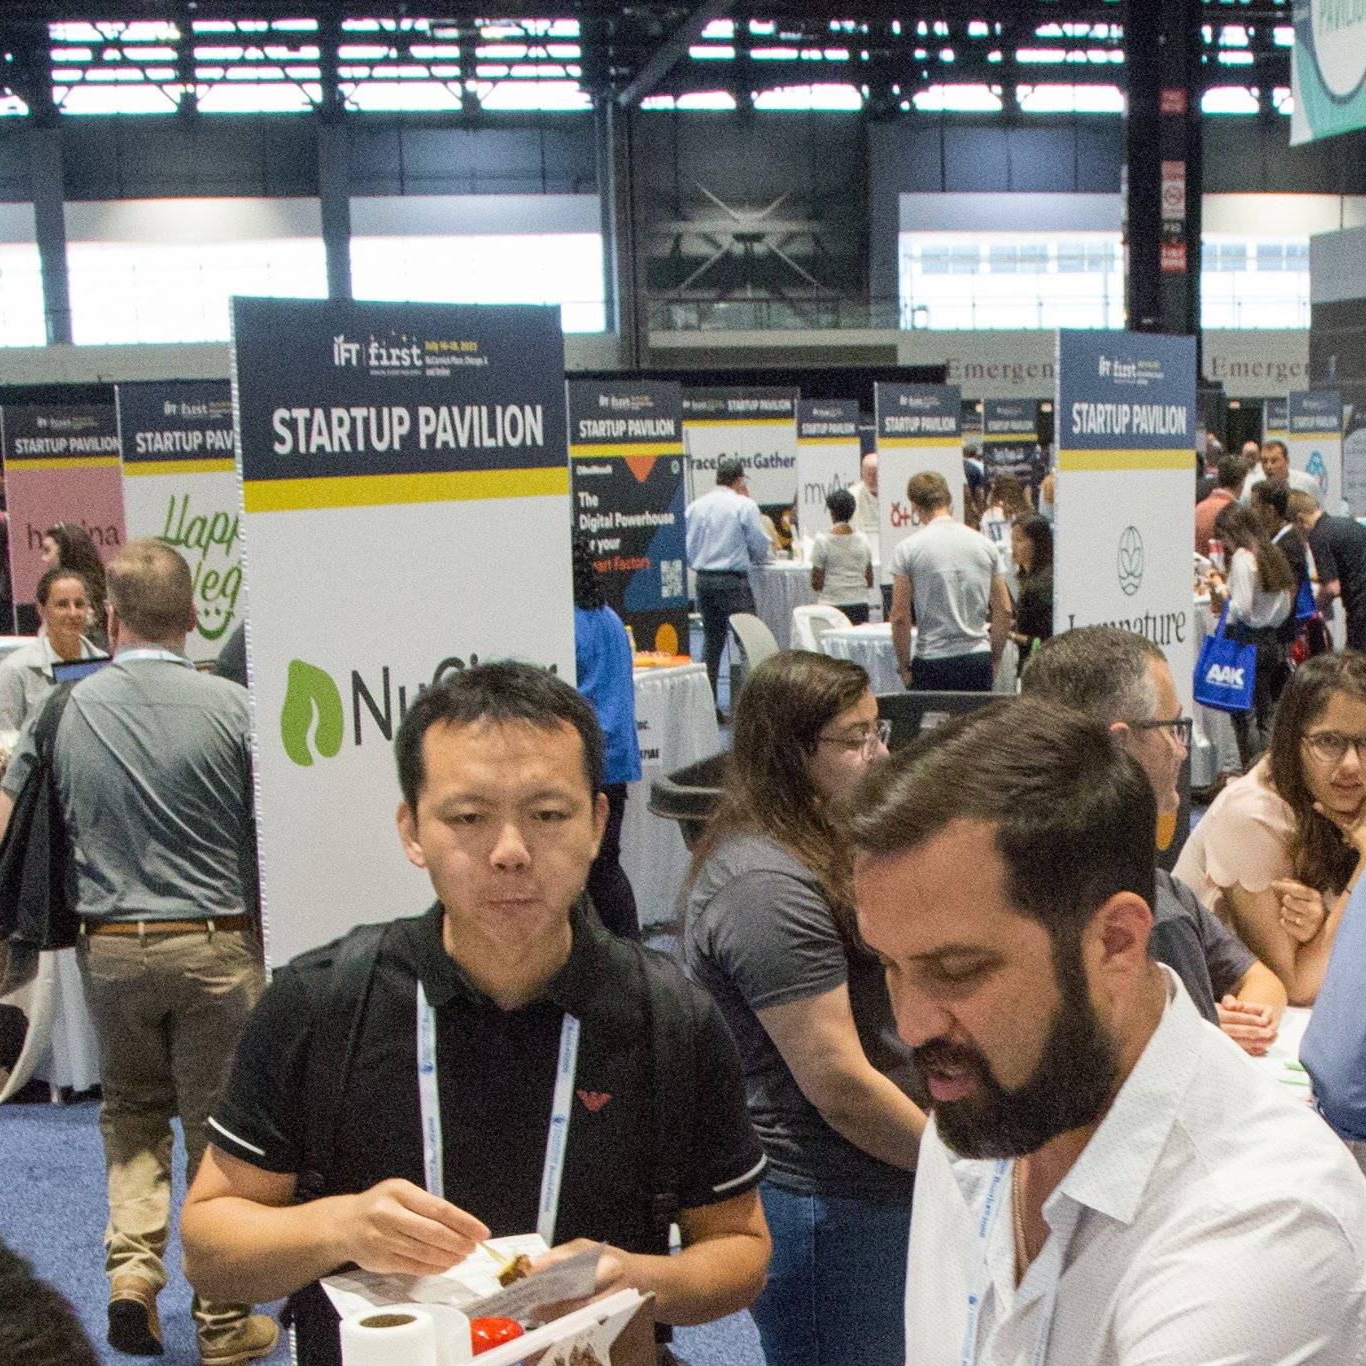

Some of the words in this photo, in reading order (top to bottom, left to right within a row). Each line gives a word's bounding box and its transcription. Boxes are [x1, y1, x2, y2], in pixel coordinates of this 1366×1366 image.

[368, 343, 423, 367] first
[947, 358, 1054, 383] Emergen
[272, 405, 411, 456] STARTUP
[418, 403, 544, 450] PAVILION
[579, 418, 627, 438] STARTUP
[629, 418, 675, 437] PAVILION
[884, 416, 920, 432] STARTUP
[921, 416, 957, 432] PAVILION
[1071, 404, 1130, 436] STARTUP
[1133, 402, 1187, 435] PAVILION
[15, 435, 68, 455] STARTUP
[69, 433, 120, 452] PAVILION
[136, 431, 203, 454] STARTUP
[754, 450, 796, 469] Gather
[578, 491, 599, 508] The
[580, 512, 613, 533] Digital
[615, 511, 675, 528] Powerhouse
[1206, 662, 1245, 688] AAK
